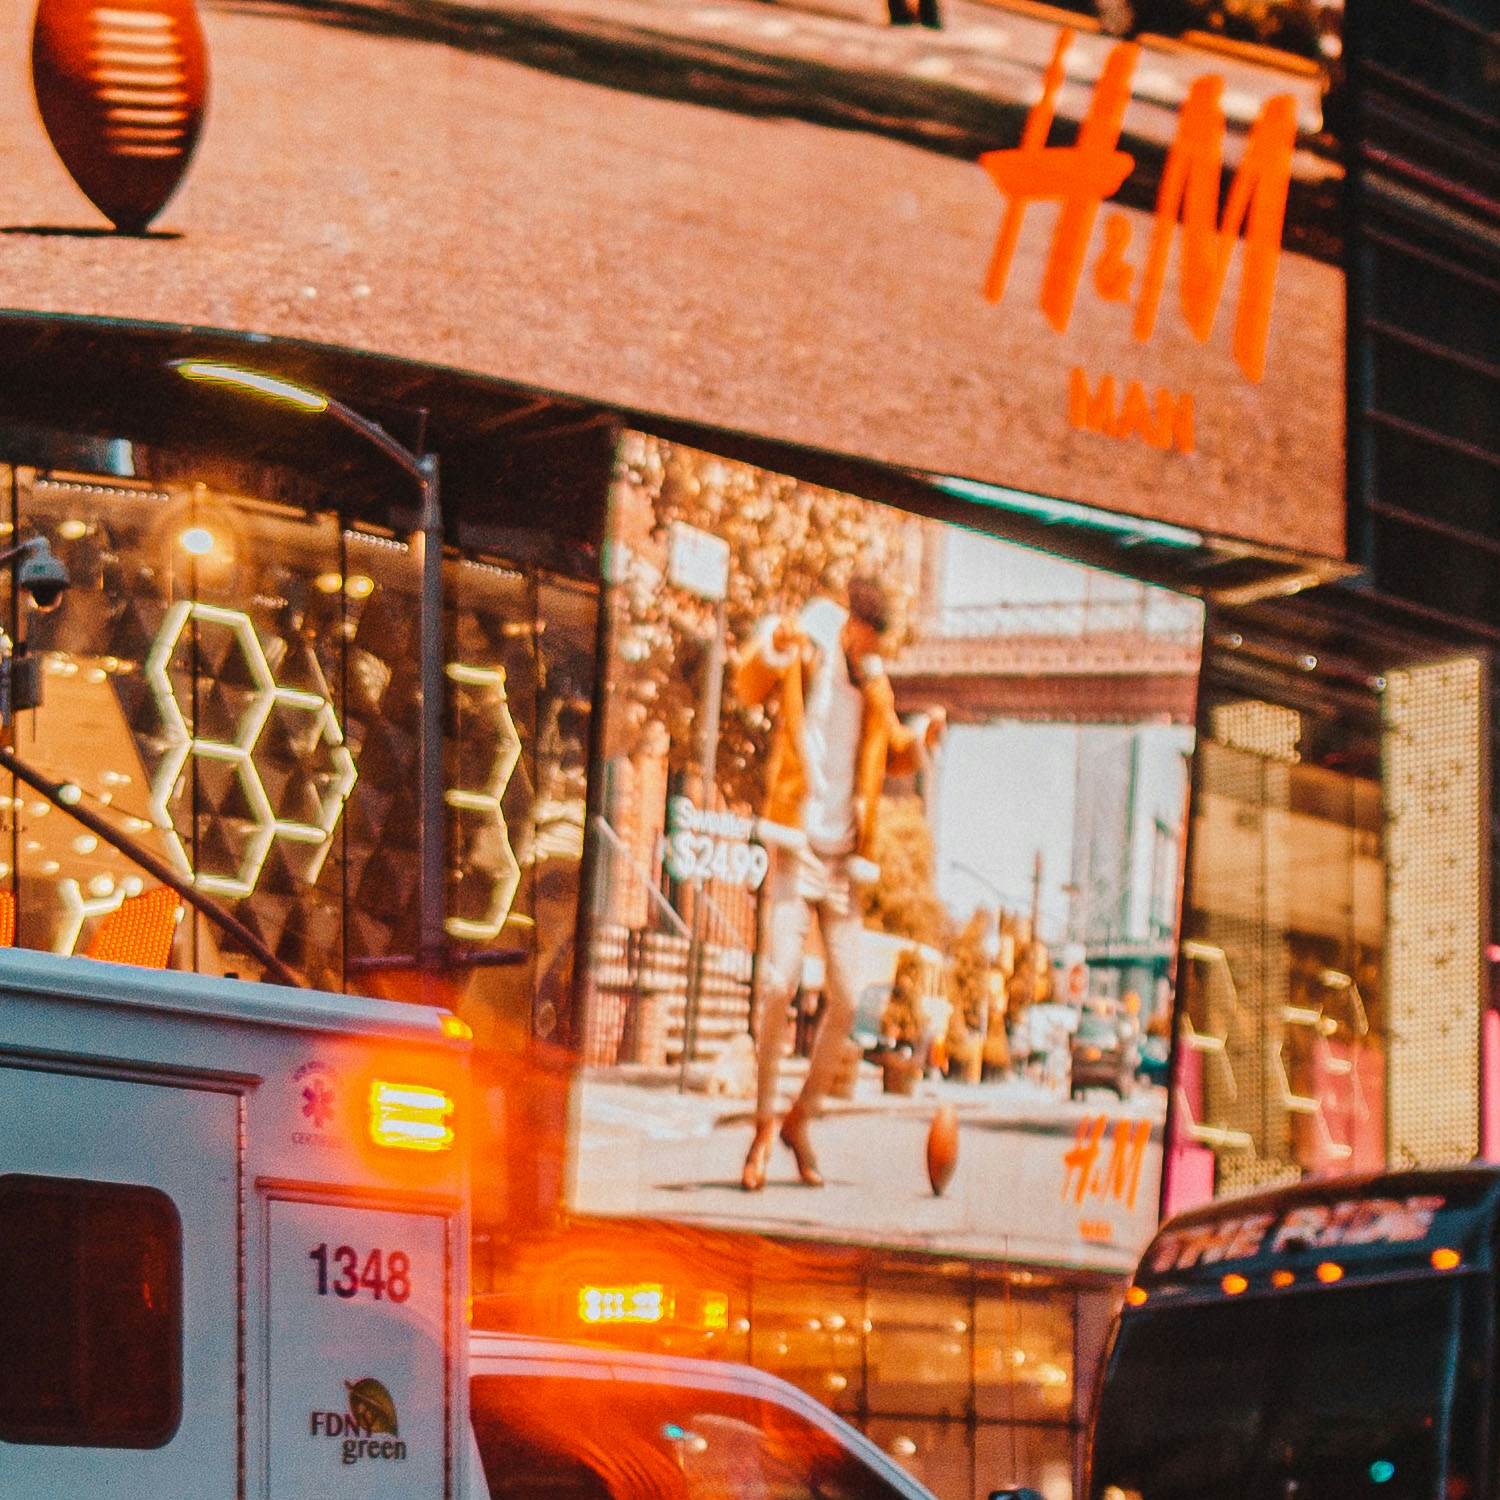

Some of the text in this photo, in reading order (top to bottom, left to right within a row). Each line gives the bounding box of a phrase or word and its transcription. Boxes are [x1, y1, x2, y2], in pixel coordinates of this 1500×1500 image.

[978, 27, 1297, 385] H&M
[1069, 366, 1196, 455] MAN
[309, 1242, 412, 1304] 1348
[310, 1410, 377, 1438] FDNY
[341, 1438, 408, 1465] green
